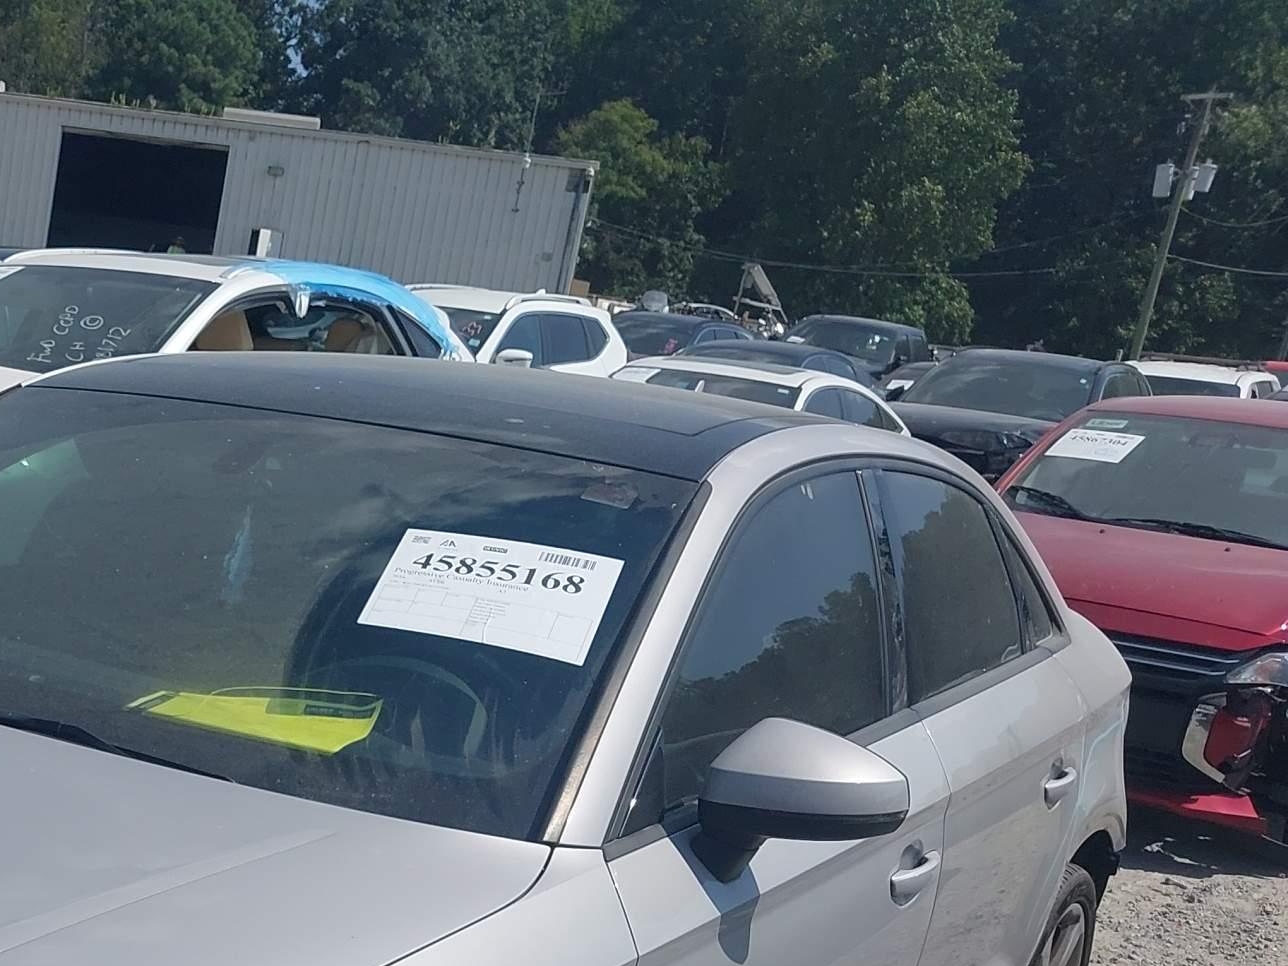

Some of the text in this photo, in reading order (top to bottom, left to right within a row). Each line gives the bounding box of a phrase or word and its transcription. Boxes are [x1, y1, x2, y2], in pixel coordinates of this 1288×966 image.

[394, 566, 446, 580] Progressive
[446, 573, 484, 585] Casualty
[486, 578, 529, 592] Insurance
[412, 552, 586, 595] 45855168
